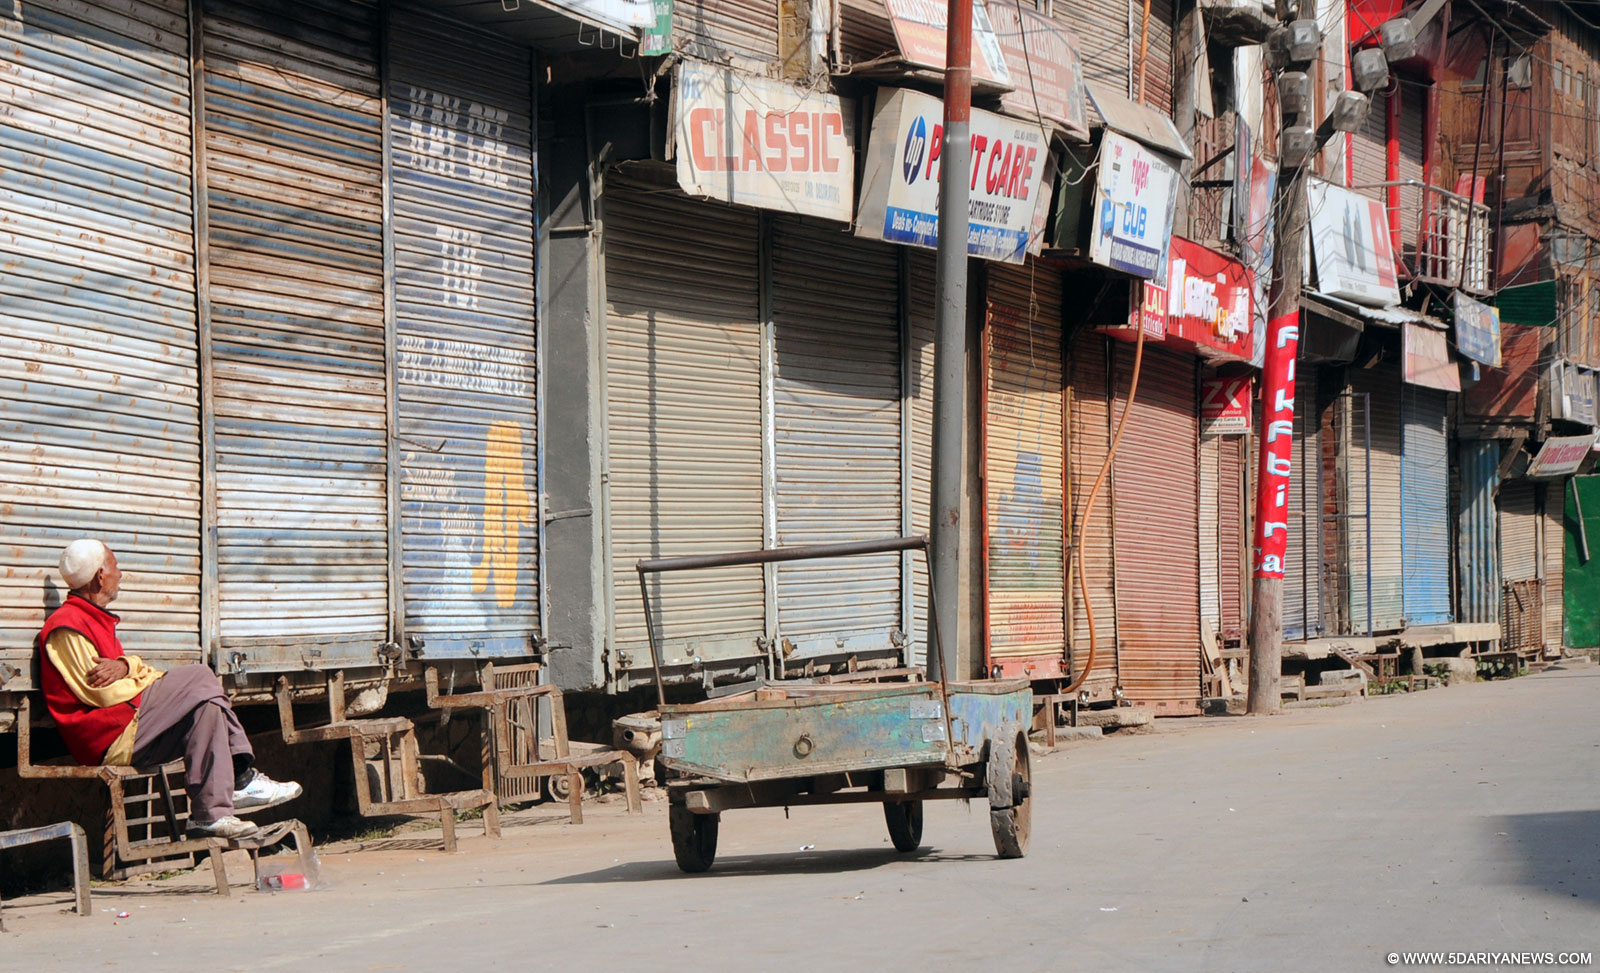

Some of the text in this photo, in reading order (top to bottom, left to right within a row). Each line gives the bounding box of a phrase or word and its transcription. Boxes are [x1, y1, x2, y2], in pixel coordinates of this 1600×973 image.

[690, 107, 842, 173] CLASSIC
[985, 139, 1038, 201] CARE
[1123, 201, 1147, 240] CUB
